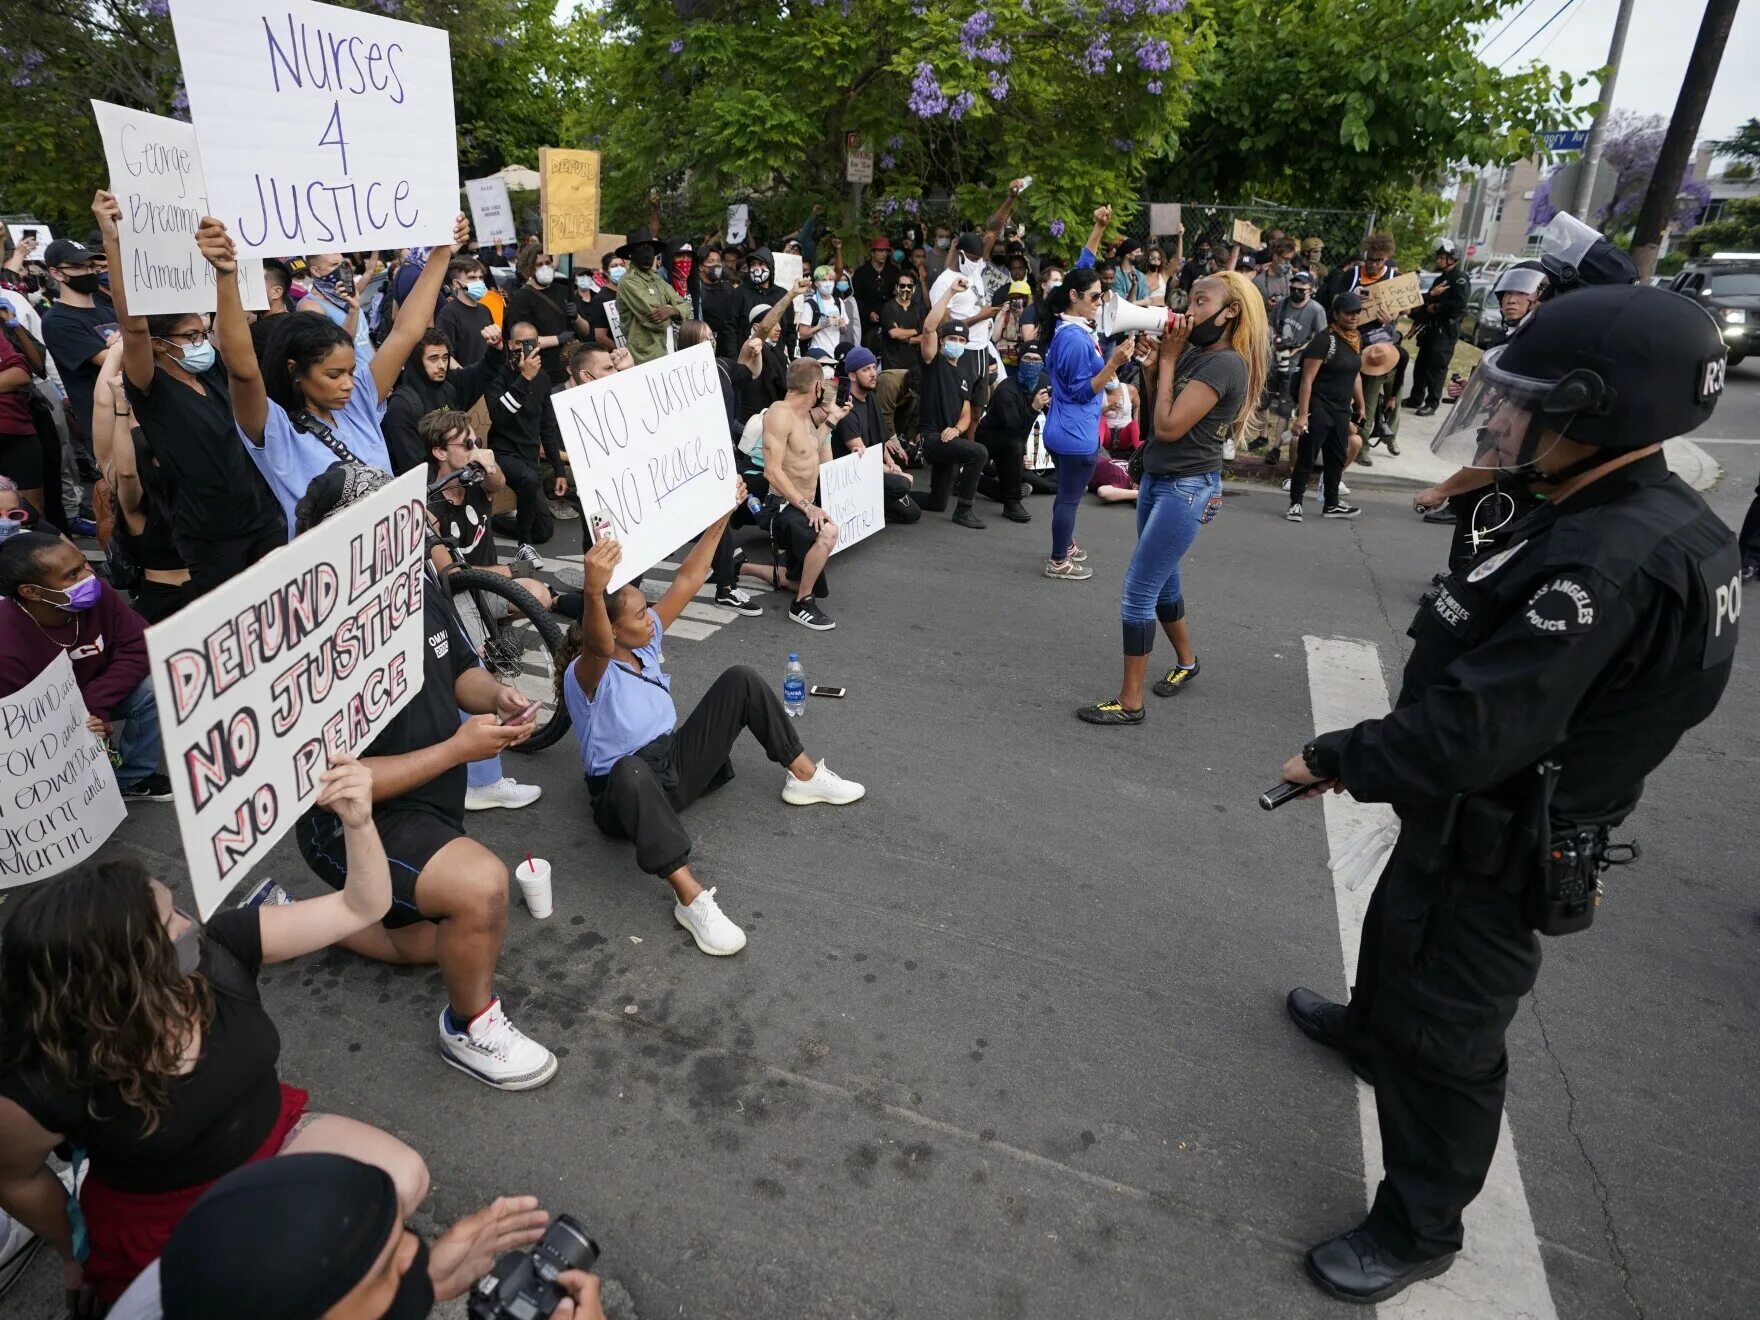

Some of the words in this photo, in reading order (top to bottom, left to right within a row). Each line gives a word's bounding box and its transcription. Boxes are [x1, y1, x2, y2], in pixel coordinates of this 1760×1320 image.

[262, 13, 404, 104] Nurses
[318, 99, 349, 176] 4
[550, 212, 594, 244] POLICE
[570, 389, 629, 468] NO
[595, 467, 642, 535] NO
[164, 561, 339, 726] DEFUND
[348, 499, 426, 606] LAPD
[1434, 597, 1461, 626] POLICE
[1525, 609, 1567, 631] POLICE
[1550, 579, 1594, 625] ANGELES
[83, 768, 106, 806] and
[184, 706, 260, 815] NO
[212, 783, 278, 881] NO
[293, 650, 408, 803] PEACE
